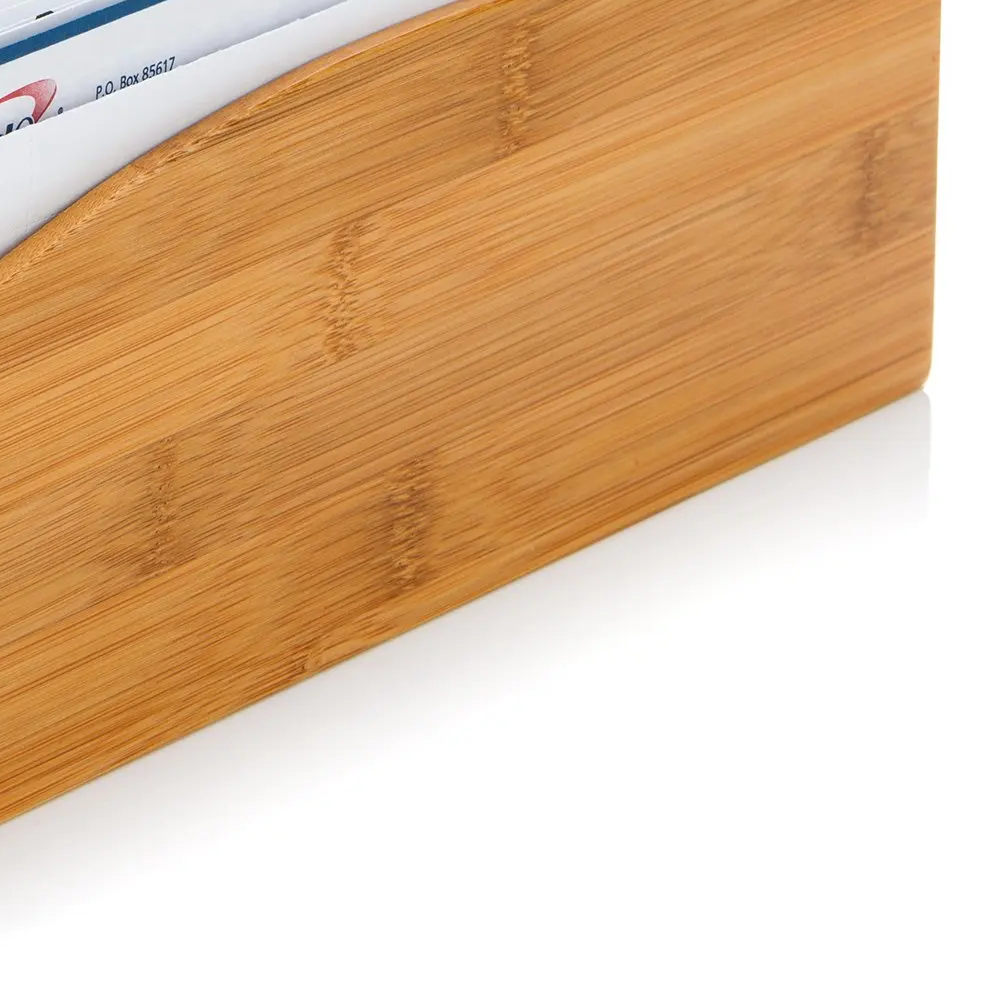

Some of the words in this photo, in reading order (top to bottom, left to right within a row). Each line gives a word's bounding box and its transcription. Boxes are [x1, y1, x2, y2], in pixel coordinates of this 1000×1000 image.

[95, 82, 117, 100] P.O.
[119, 73, 140, 90] Box
[141, 56, 177, 81] 85617
